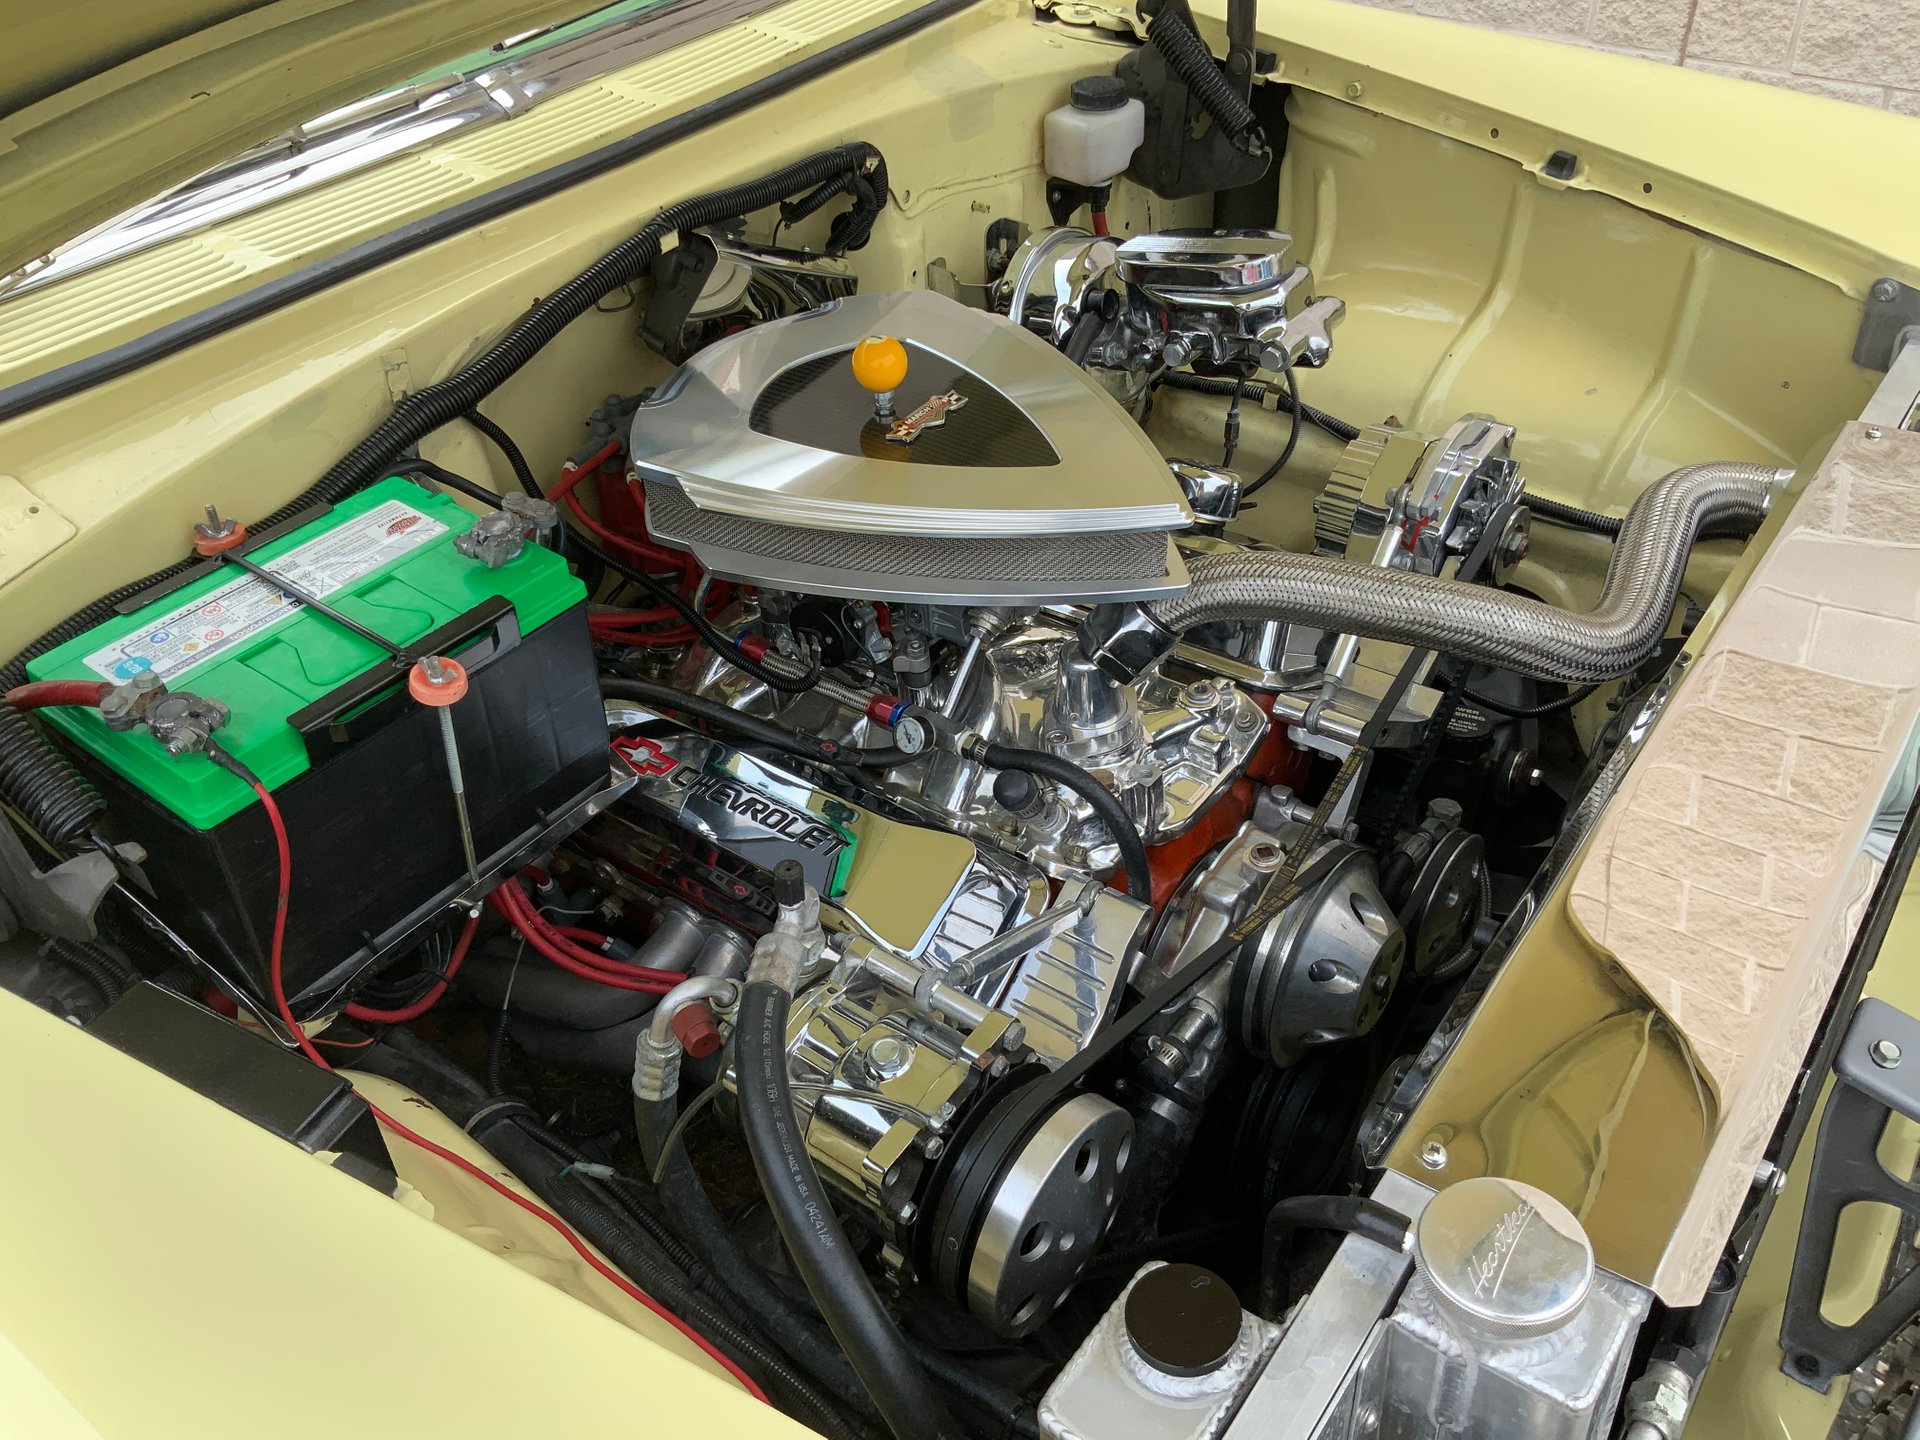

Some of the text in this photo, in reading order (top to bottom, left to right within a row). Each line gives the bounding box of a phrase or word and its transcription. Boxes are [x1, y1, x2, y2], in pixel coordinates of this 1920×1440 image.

[904, 404, 931, 425] MARCH
[1455, 707, 1480, 715] WER
[1455, 711, 1486, 722] ERING
[1448, 722, 1478, 731] PROVED
[667, 766, 851, 858] CHEVROLET
[762, 1030, 771, 1045] HOSE
[786, 1154, 800, 1173] MADE
[793, 1174, 804, 1183] IN
[798, 1183, 809, 1198] USA
[804, 1201, 836, 1250] 04241AM
[1467, 1196, 1531, 1298] Heartbea
